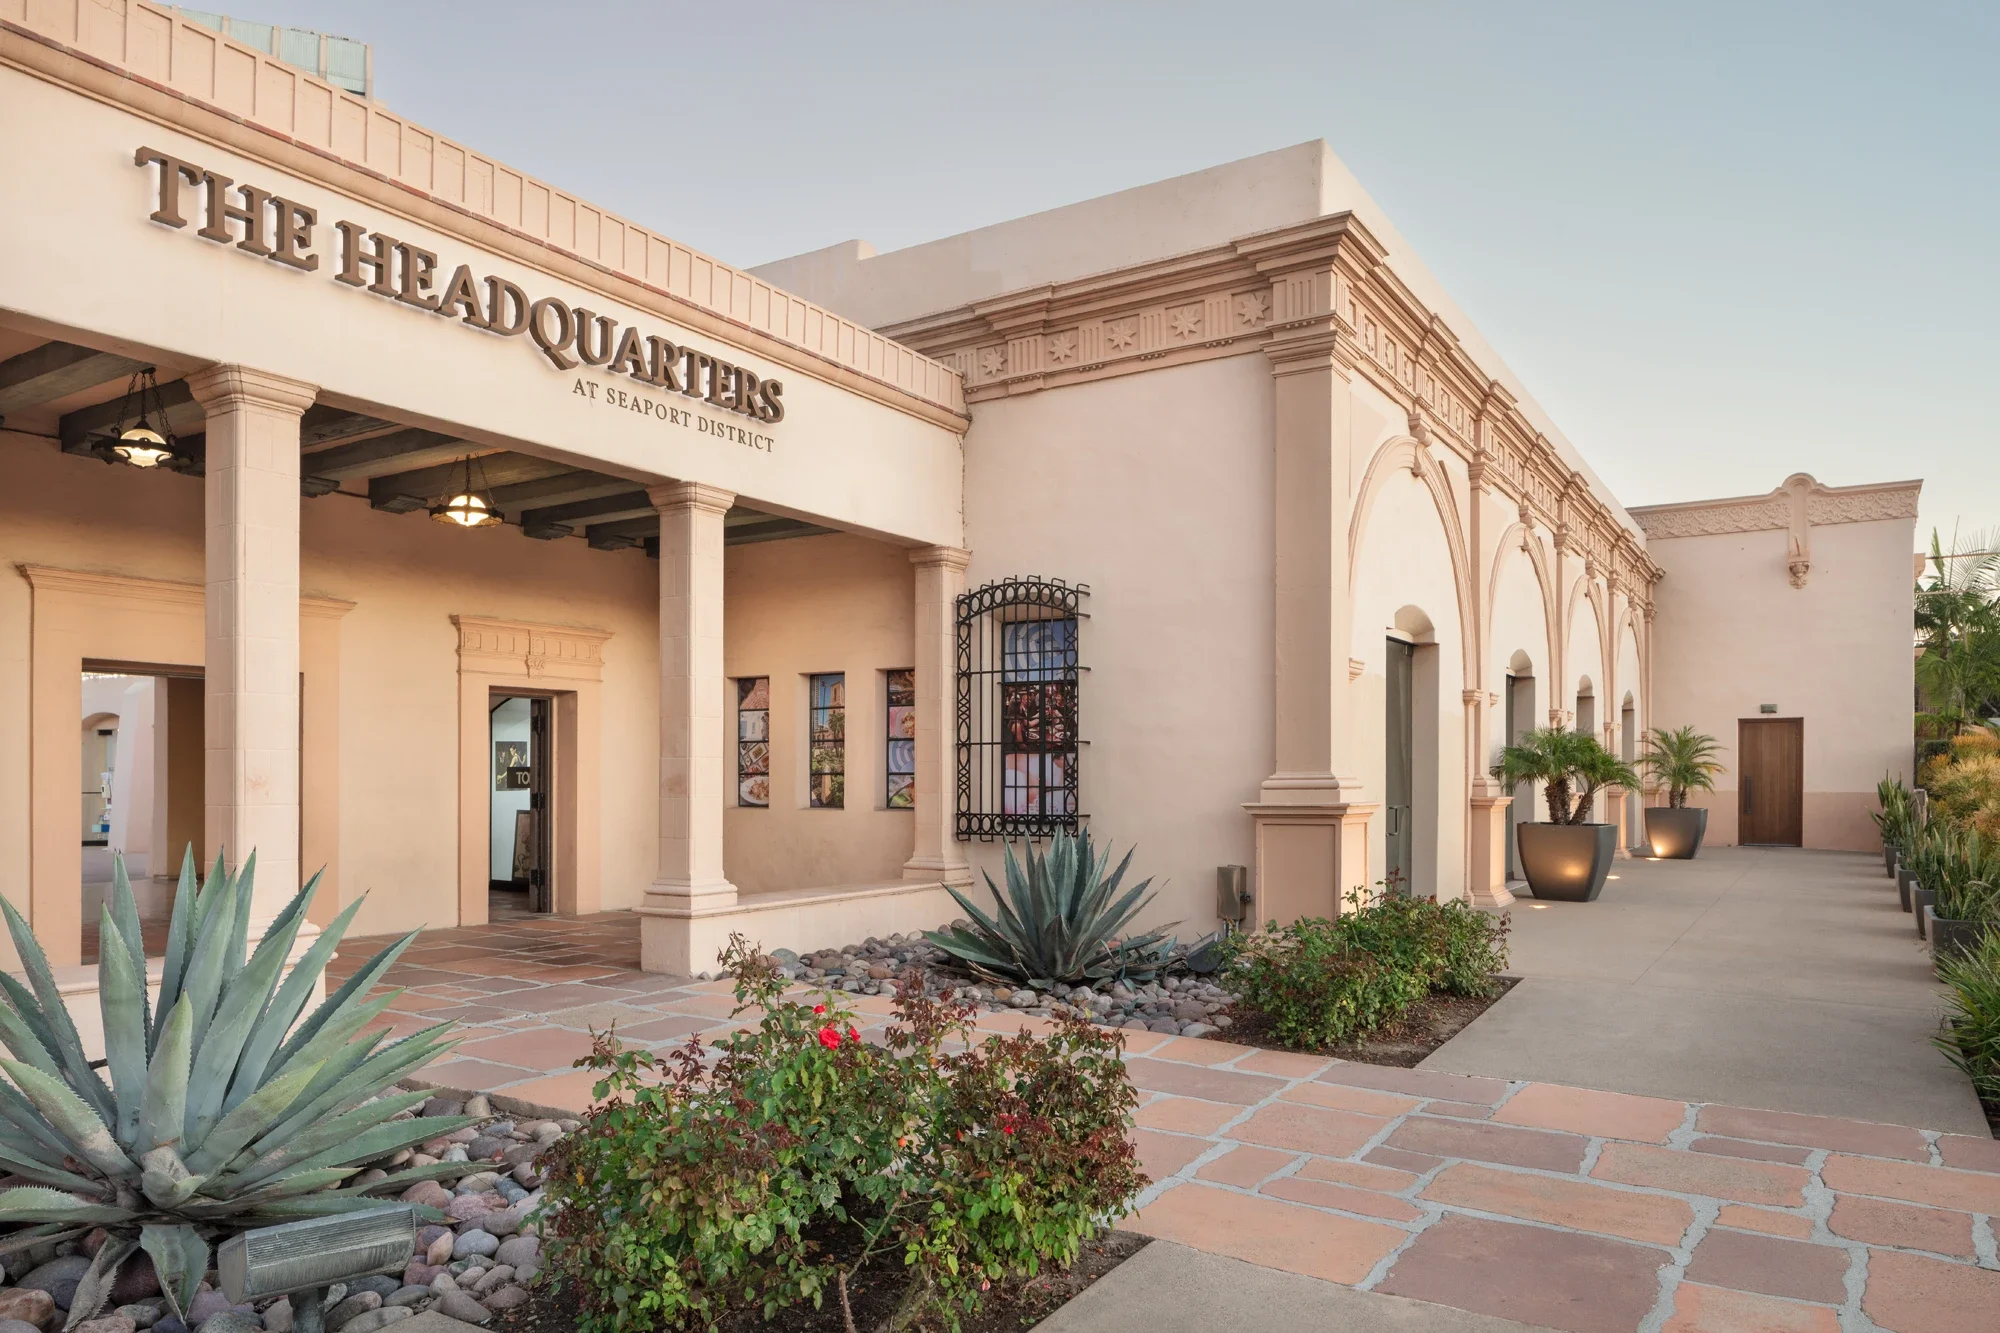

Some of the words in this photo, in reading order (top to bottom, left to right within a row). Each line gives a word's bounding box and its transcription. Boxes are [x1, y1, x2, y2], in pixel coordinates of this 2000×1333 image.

[135, 145, 319, 272] THE
[334, 219, 785, 423] HEADQUARTERS
[572, 378, 598, 399] AT
[606, 387, 691, 428] SEAPORT
[697, 416, 774, 453] DISTRICT
